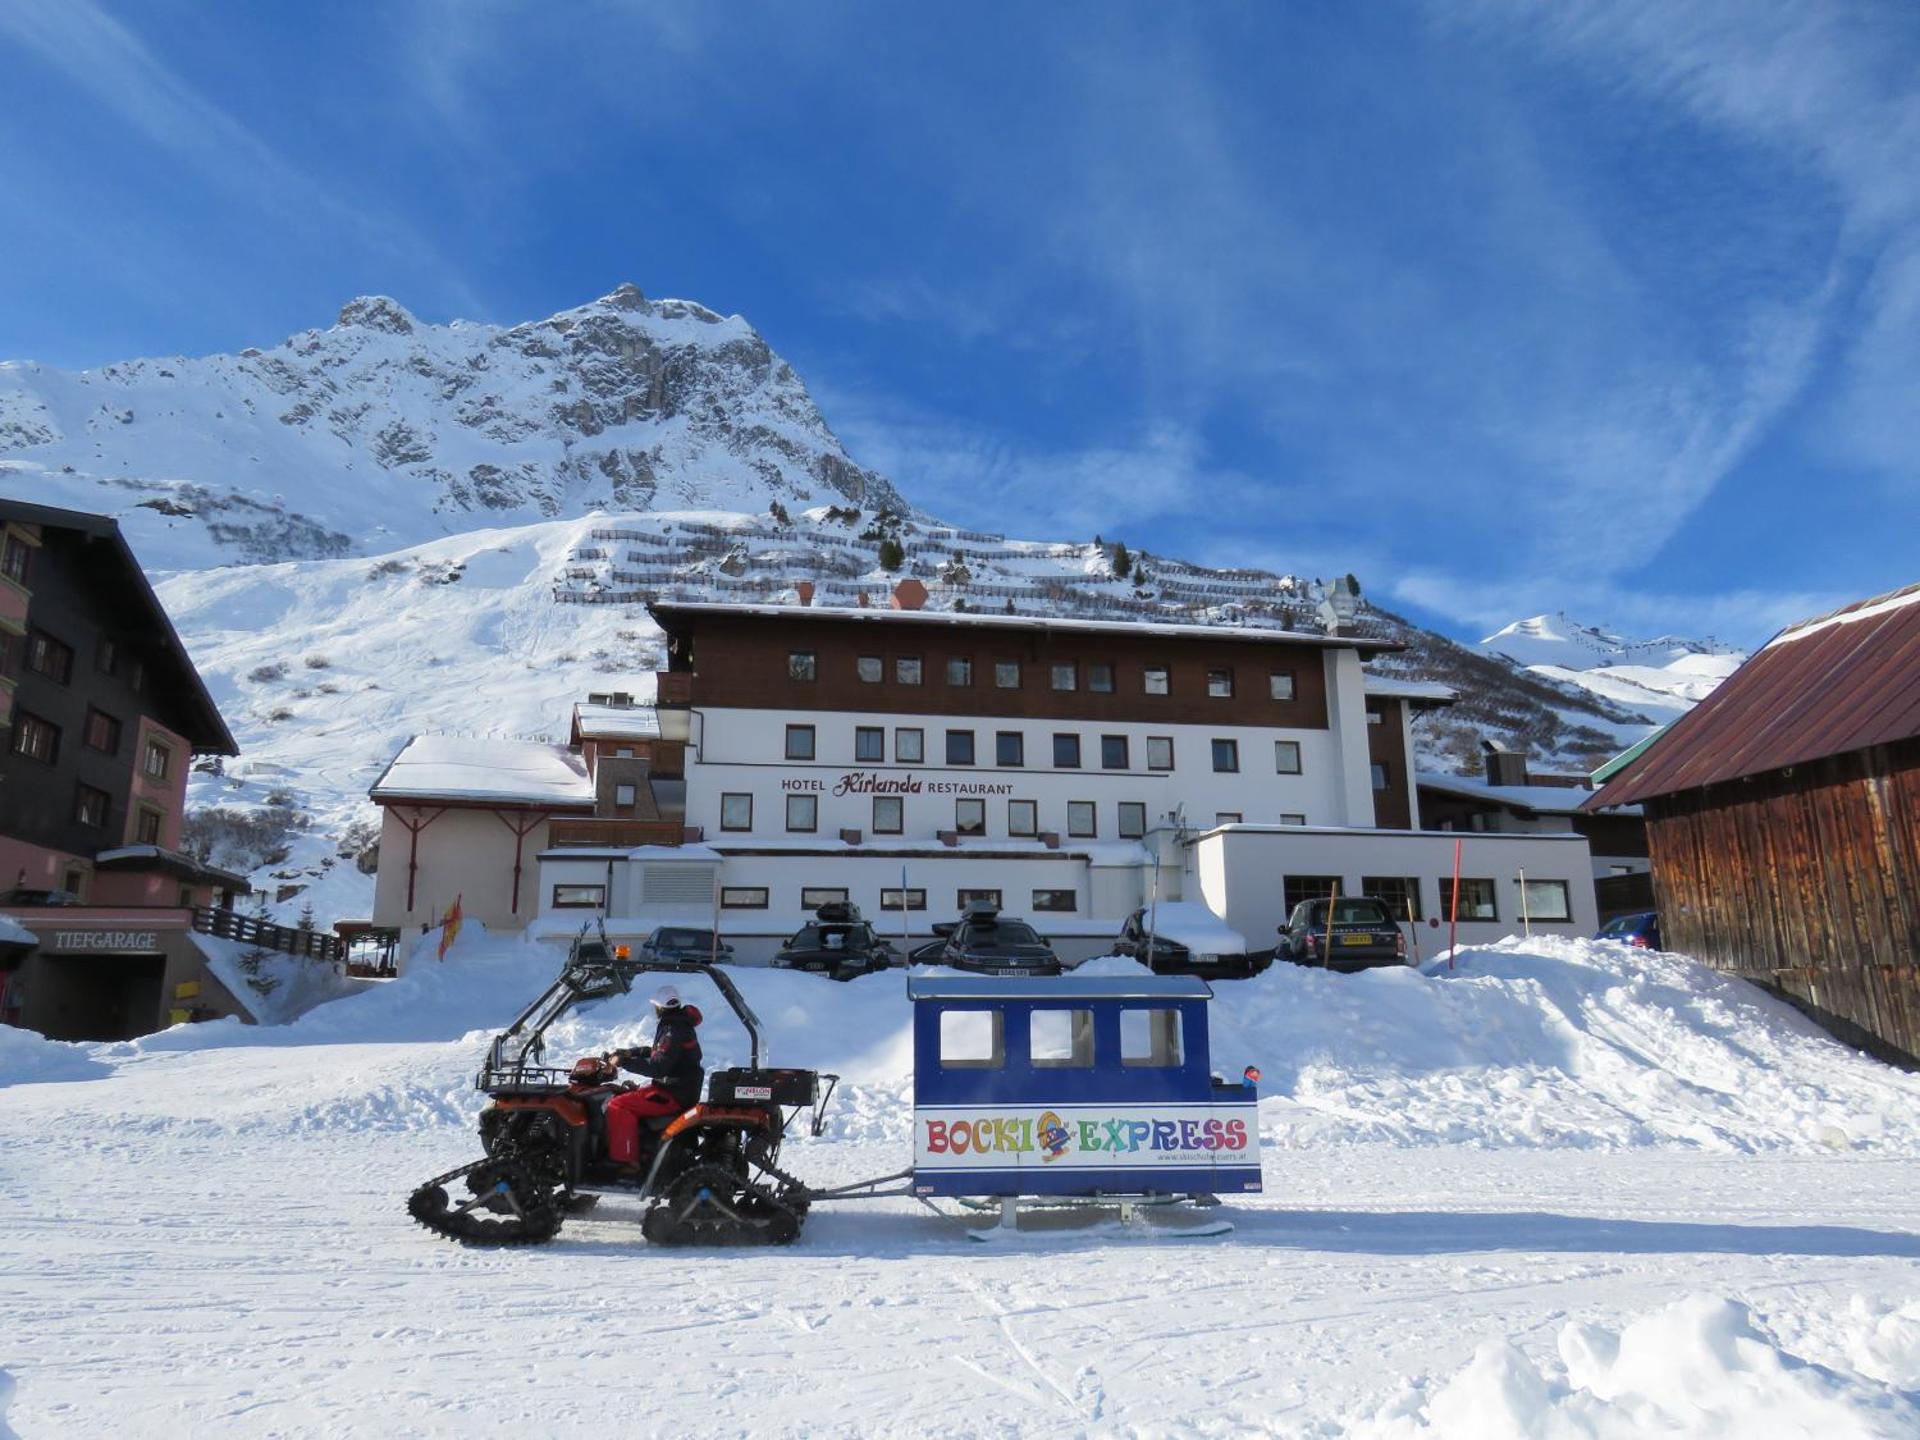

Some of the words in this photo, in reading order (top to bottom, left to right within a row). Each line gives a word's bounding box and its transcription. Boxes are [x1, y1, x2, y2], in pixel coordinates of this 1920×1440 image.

[782, 779, 826, 791] HOTEL
[928, 782, 1014, 795] RESTAURANT
[55, 932, 158, 949] TIEFGARAGE
[926, 1117, 1036, 1154] BOCKI
[1077, 1117, 1249, 1152] EXPRESS
